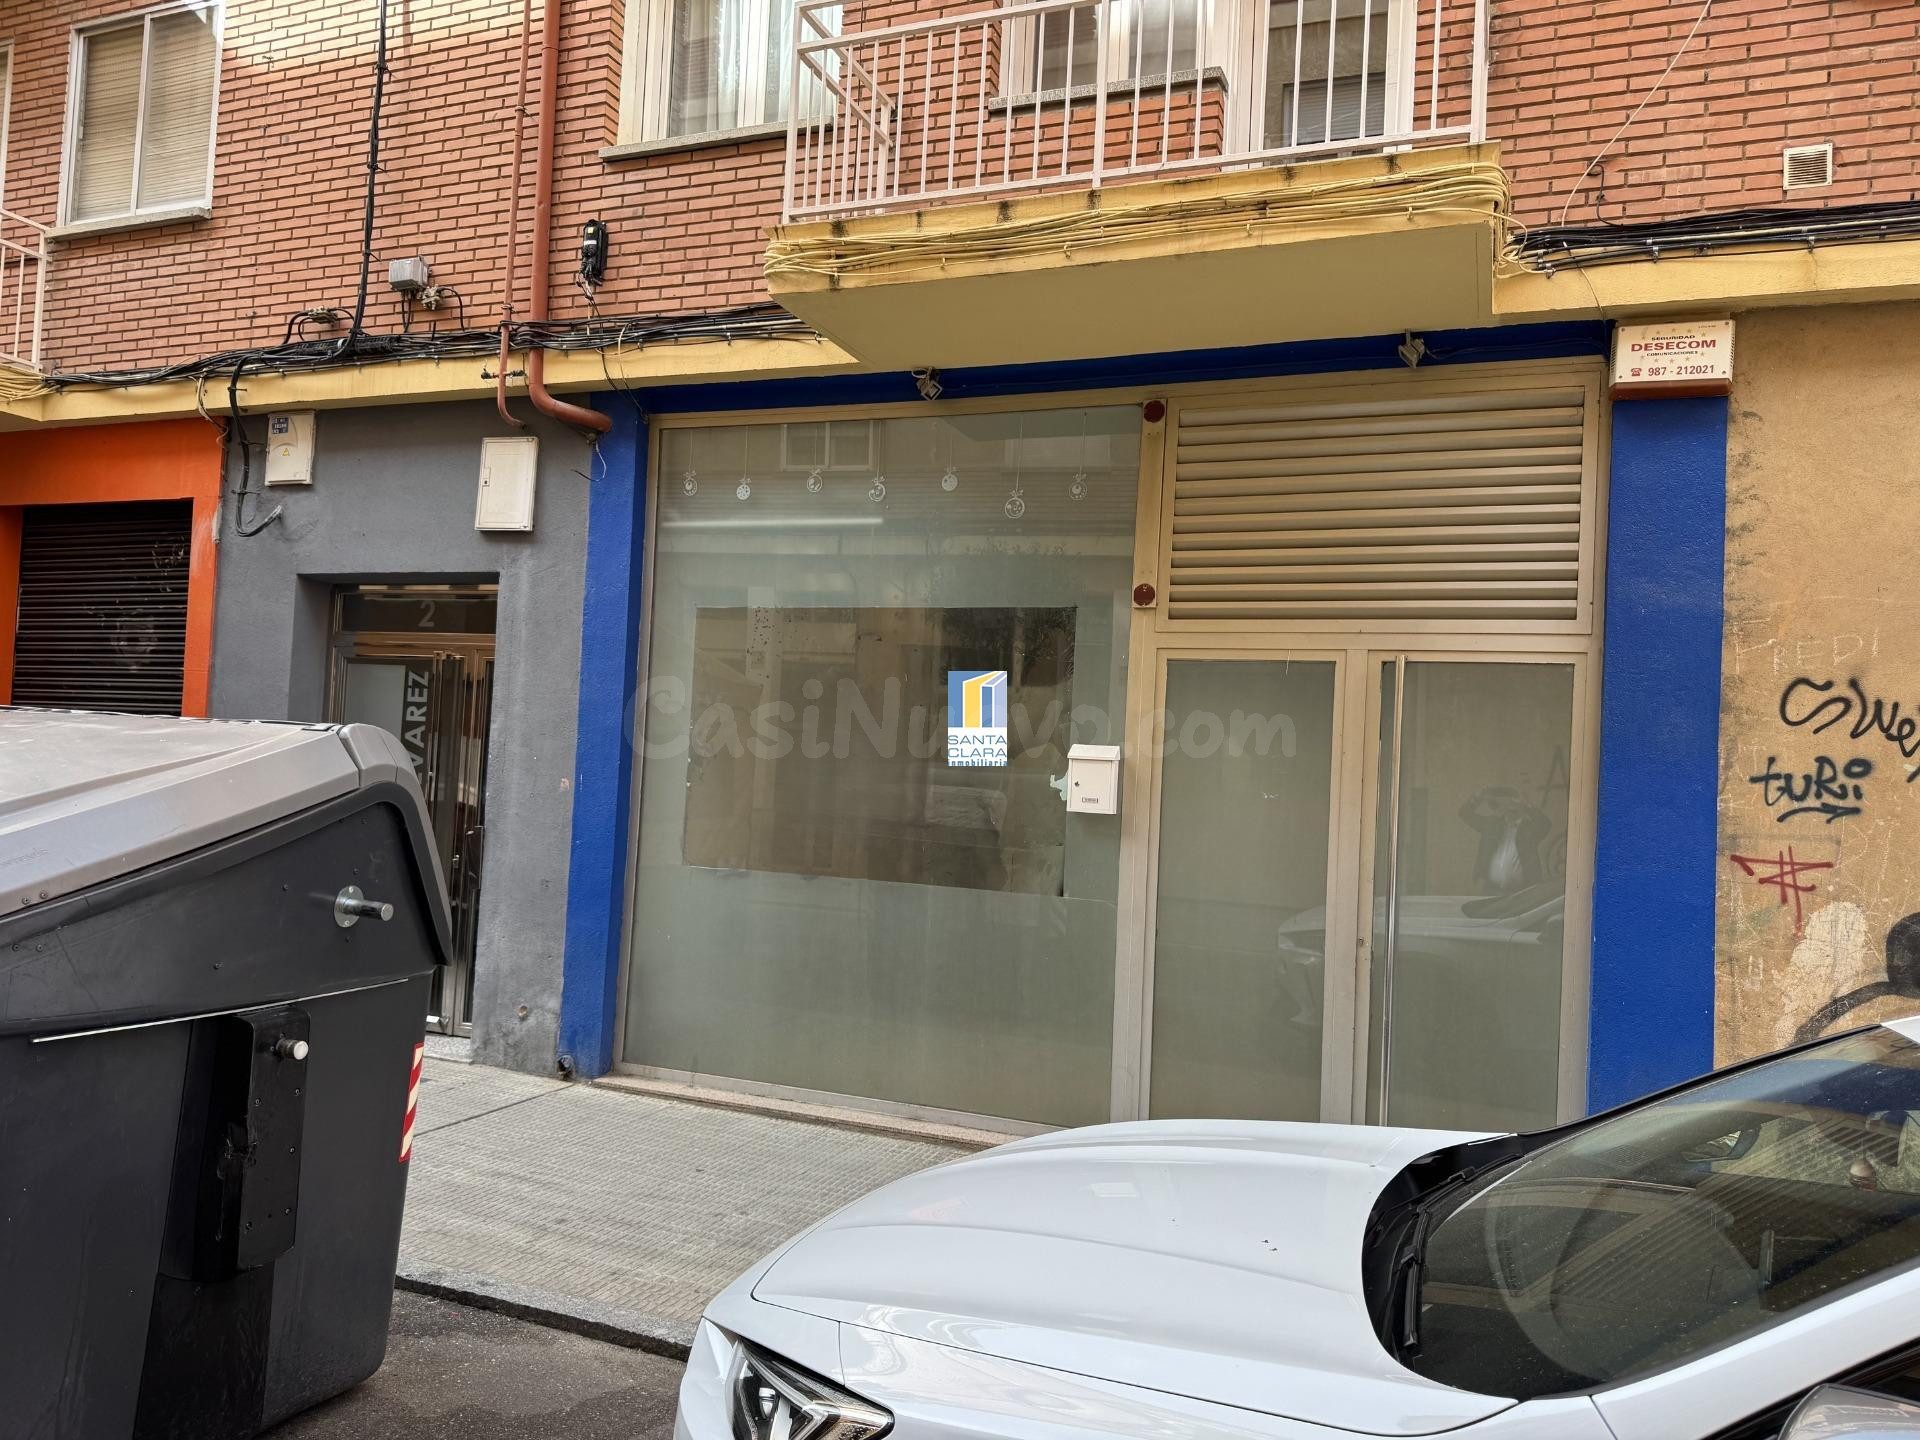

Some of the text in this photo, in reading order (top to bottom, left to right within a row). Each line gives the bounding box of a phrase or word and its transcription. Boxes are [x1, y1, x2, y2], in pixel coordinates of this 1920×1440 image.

[1631, 339, 1716, 352] DESECOM
[1648, 367, 1667, 377] 987
[1676, 364, 1714, 375] 212021
[418, 600, 436, 627] 2
[405, 670, 429, 784] VAREZ
